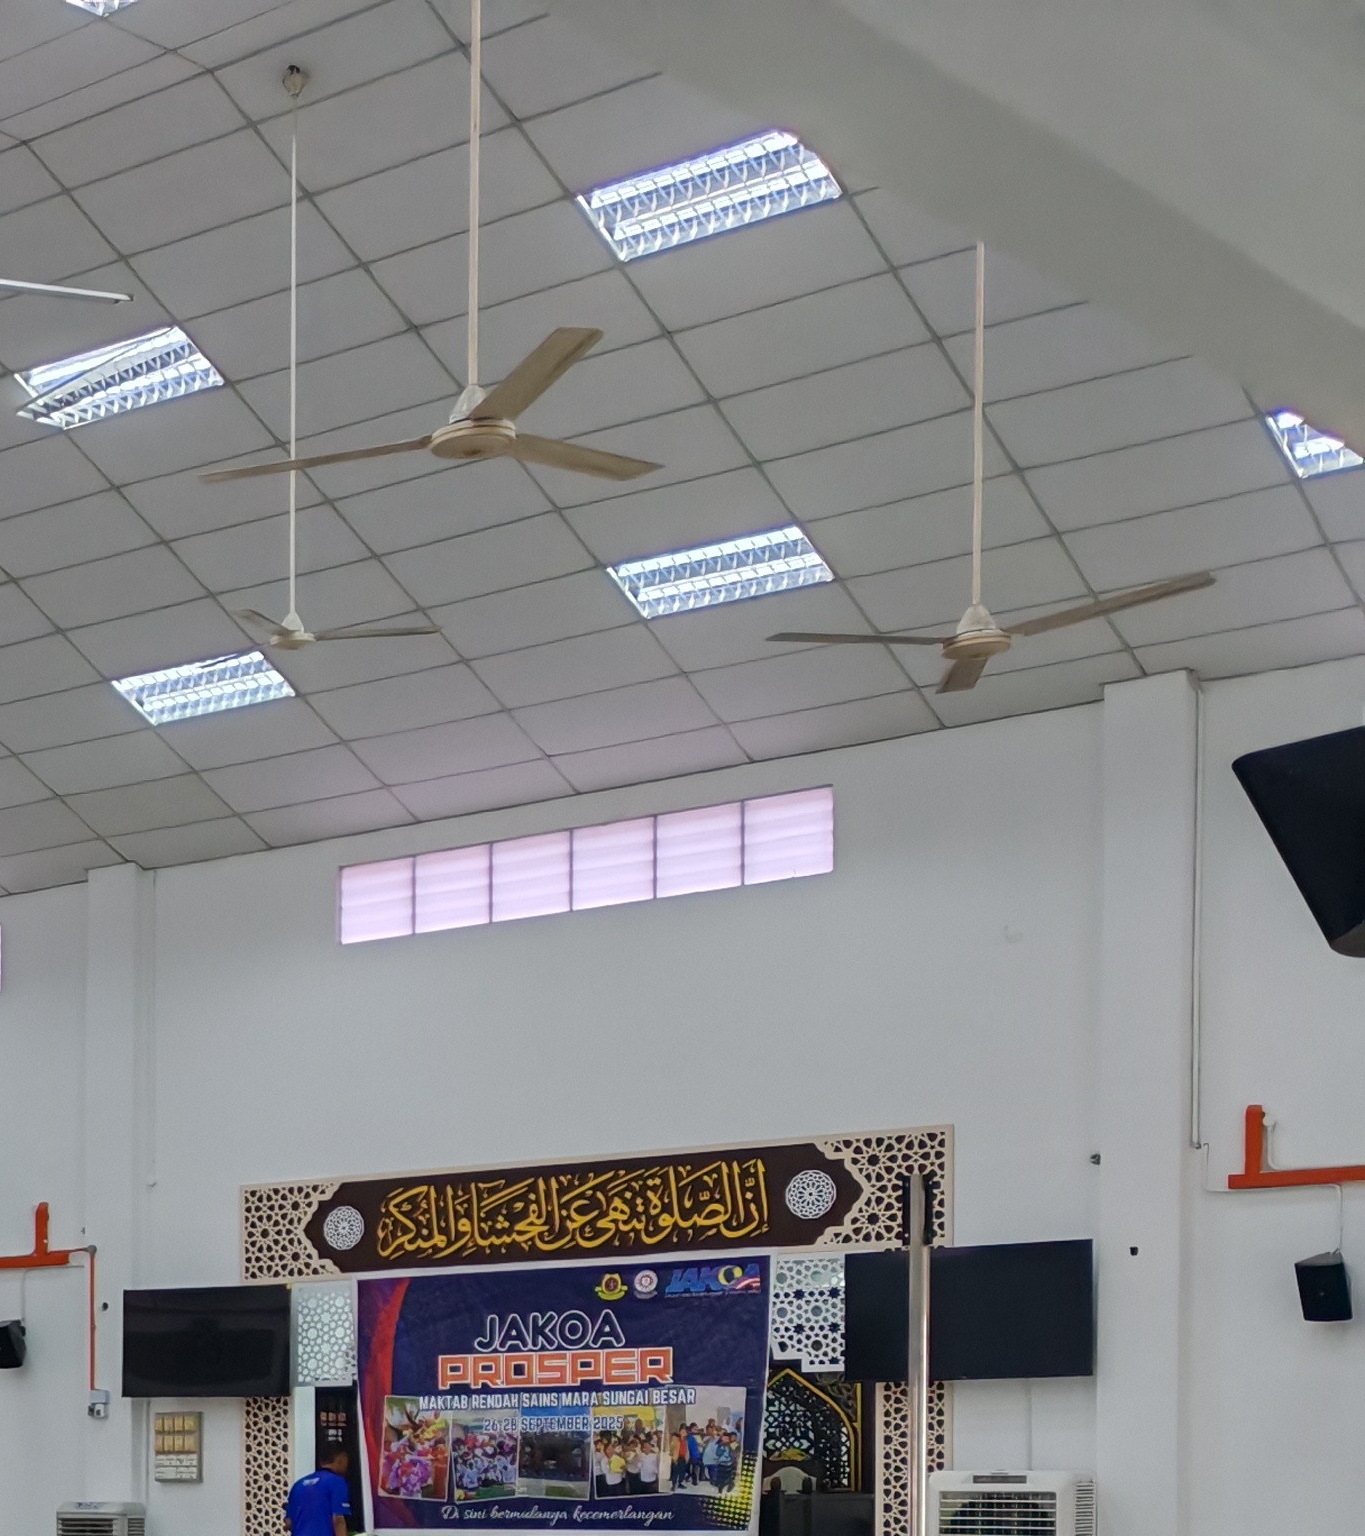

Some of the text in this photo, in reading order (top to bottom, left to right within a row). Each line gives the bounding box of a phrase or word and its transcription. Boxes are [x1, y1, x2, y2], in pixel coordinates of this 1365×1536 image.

[474, 1309, 626, 1352] JAKOA
[438, 1346, 673, 1390] PROSPER
[419, 1388, 696, 1410] MAKTAB RENDAH SAINS MARA SUNGAI BESAR
[521, 1416, 590, 1432] SEPTEMBER
[593, 1415, 624, 1431] 2025
[441, 1505, 674, 1527] Di sini bermulanya kecemerlangan
